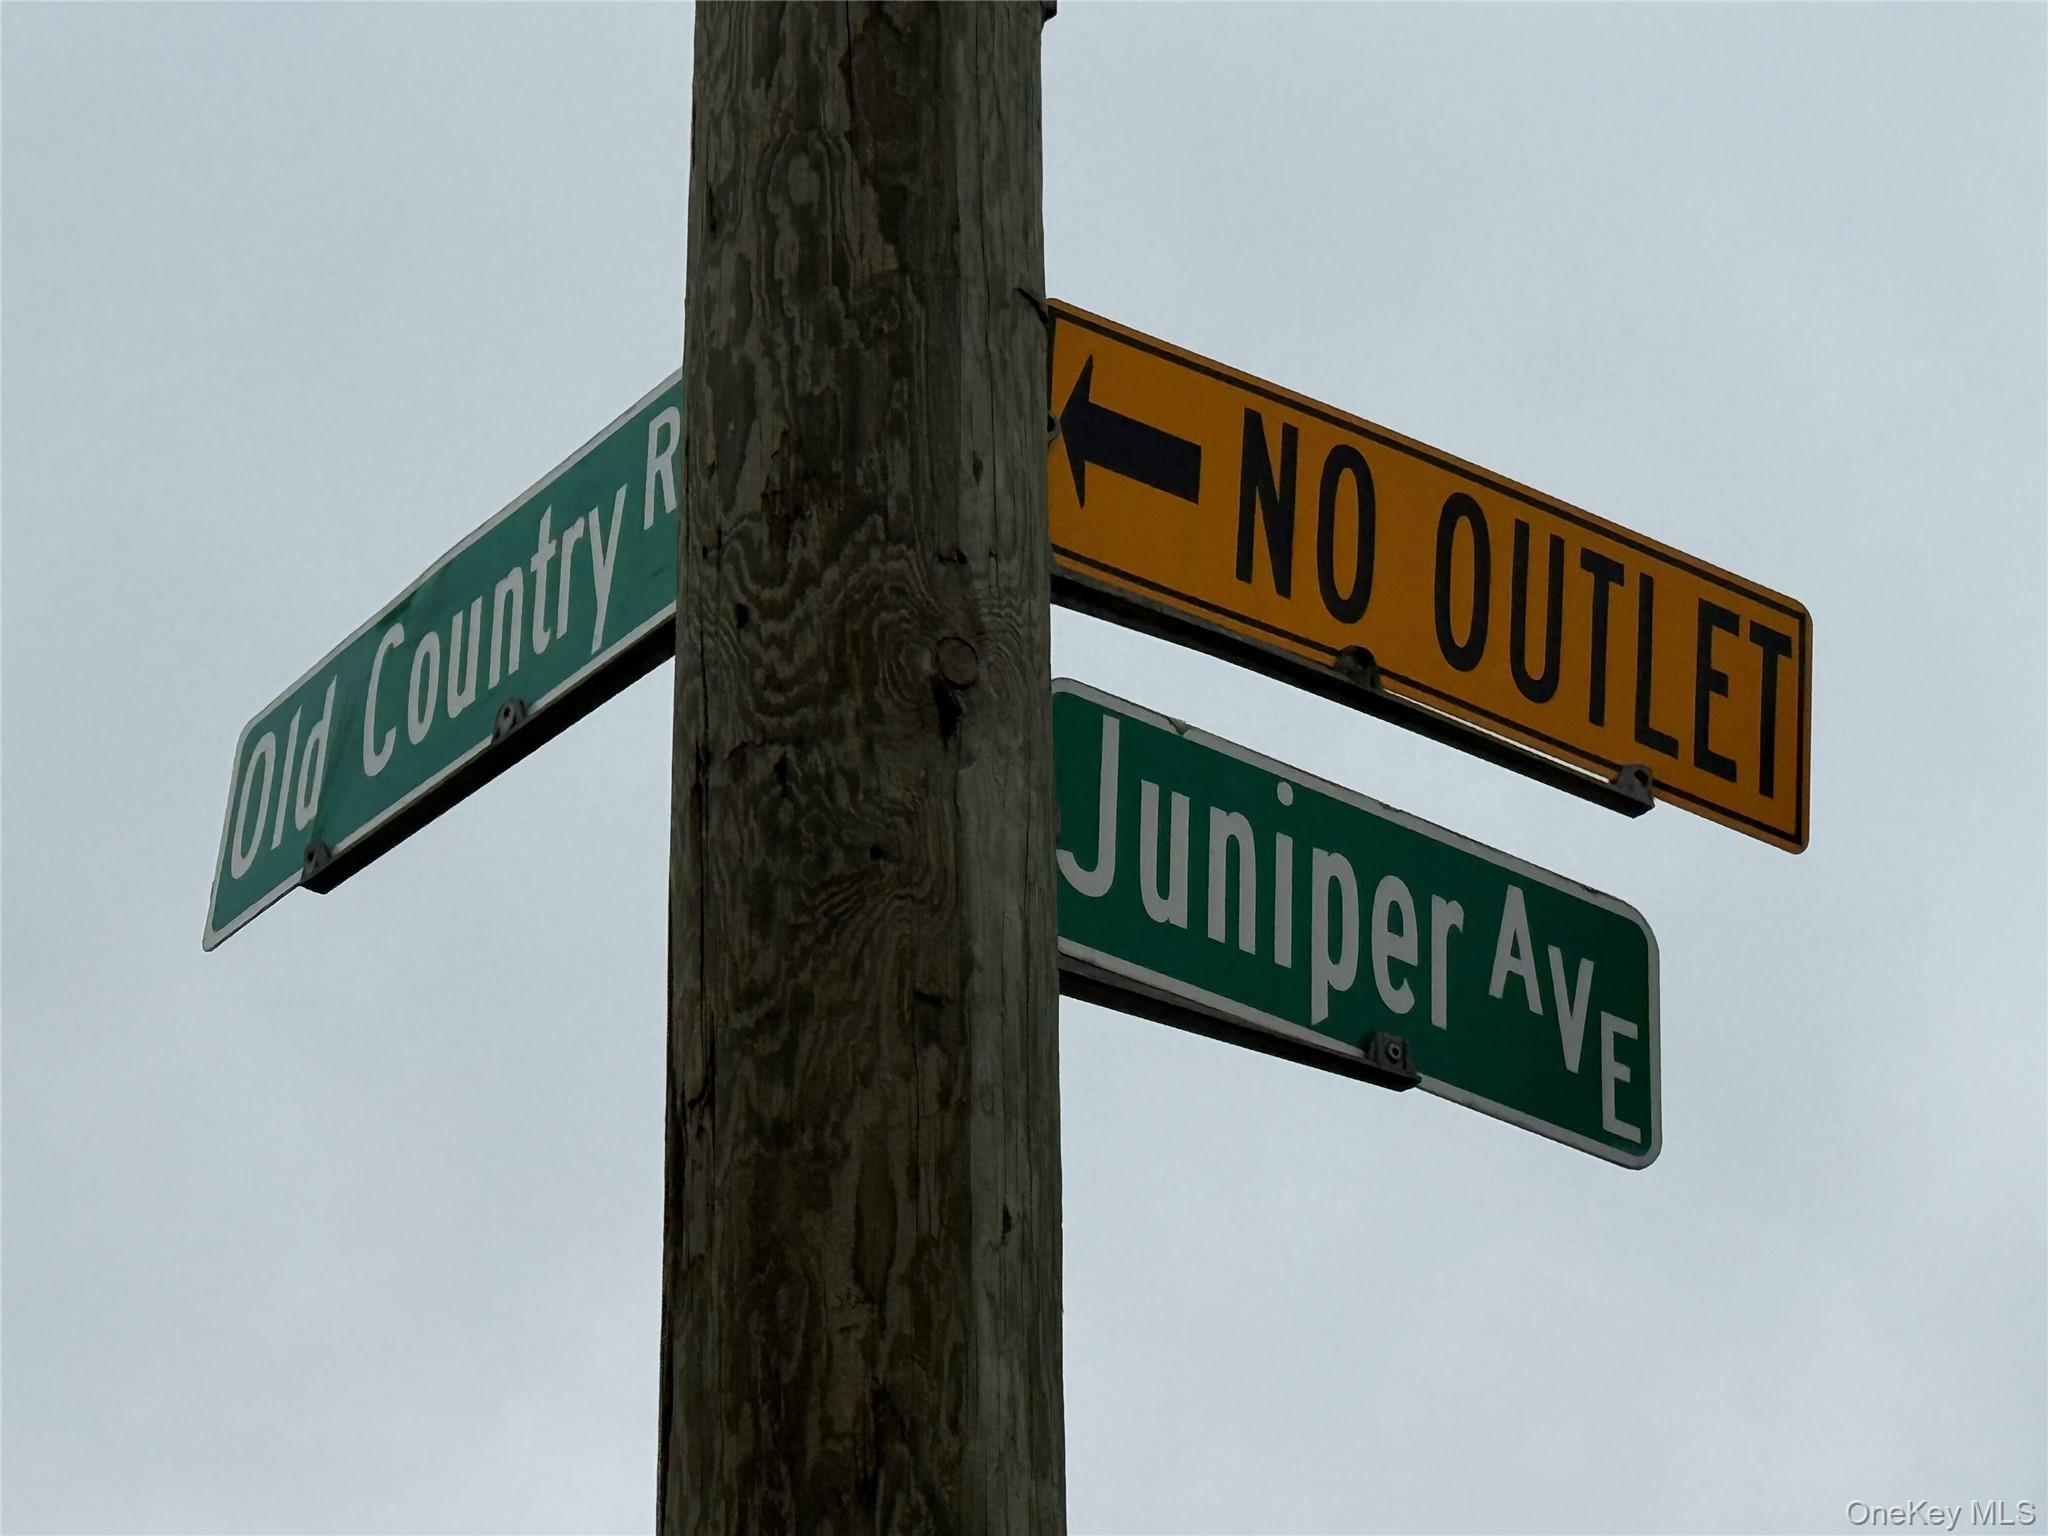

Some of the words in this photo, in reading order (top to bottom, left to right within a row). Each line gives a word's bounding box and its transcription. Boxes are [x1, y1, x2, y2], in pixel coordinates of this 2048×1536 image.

[230, 672, 338, 880] Old
[363, 482, 628, 777] Country
[1235, 406, 1376, 625] NO
[1433, 491, 1793, 800] OUTLET
[1055, 714, 1465, 1031] Juniper
[1488, 883, 1642, 1144] AVE
